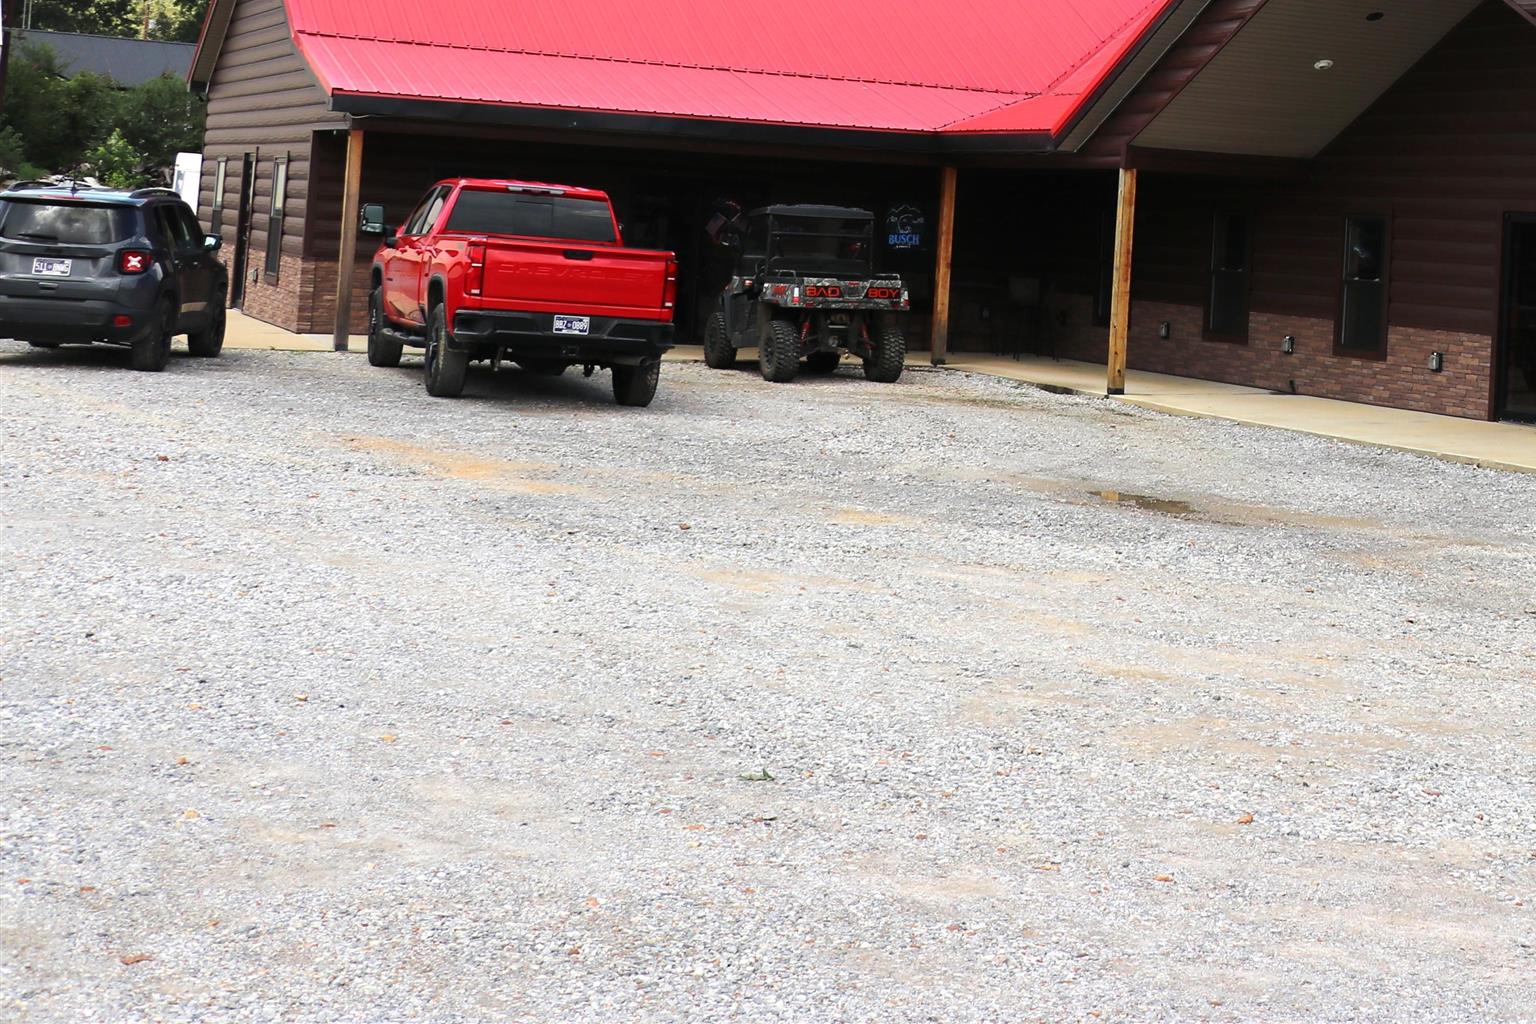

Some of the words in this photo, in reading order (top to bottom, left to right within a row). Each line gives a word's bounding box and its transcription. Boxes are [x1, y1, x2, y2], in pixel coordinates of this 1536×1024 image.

[888, 233, 920, 245] BUSCH
[806, 286, 840, 297] BAD
[868, 288, 899, 298] BOY
